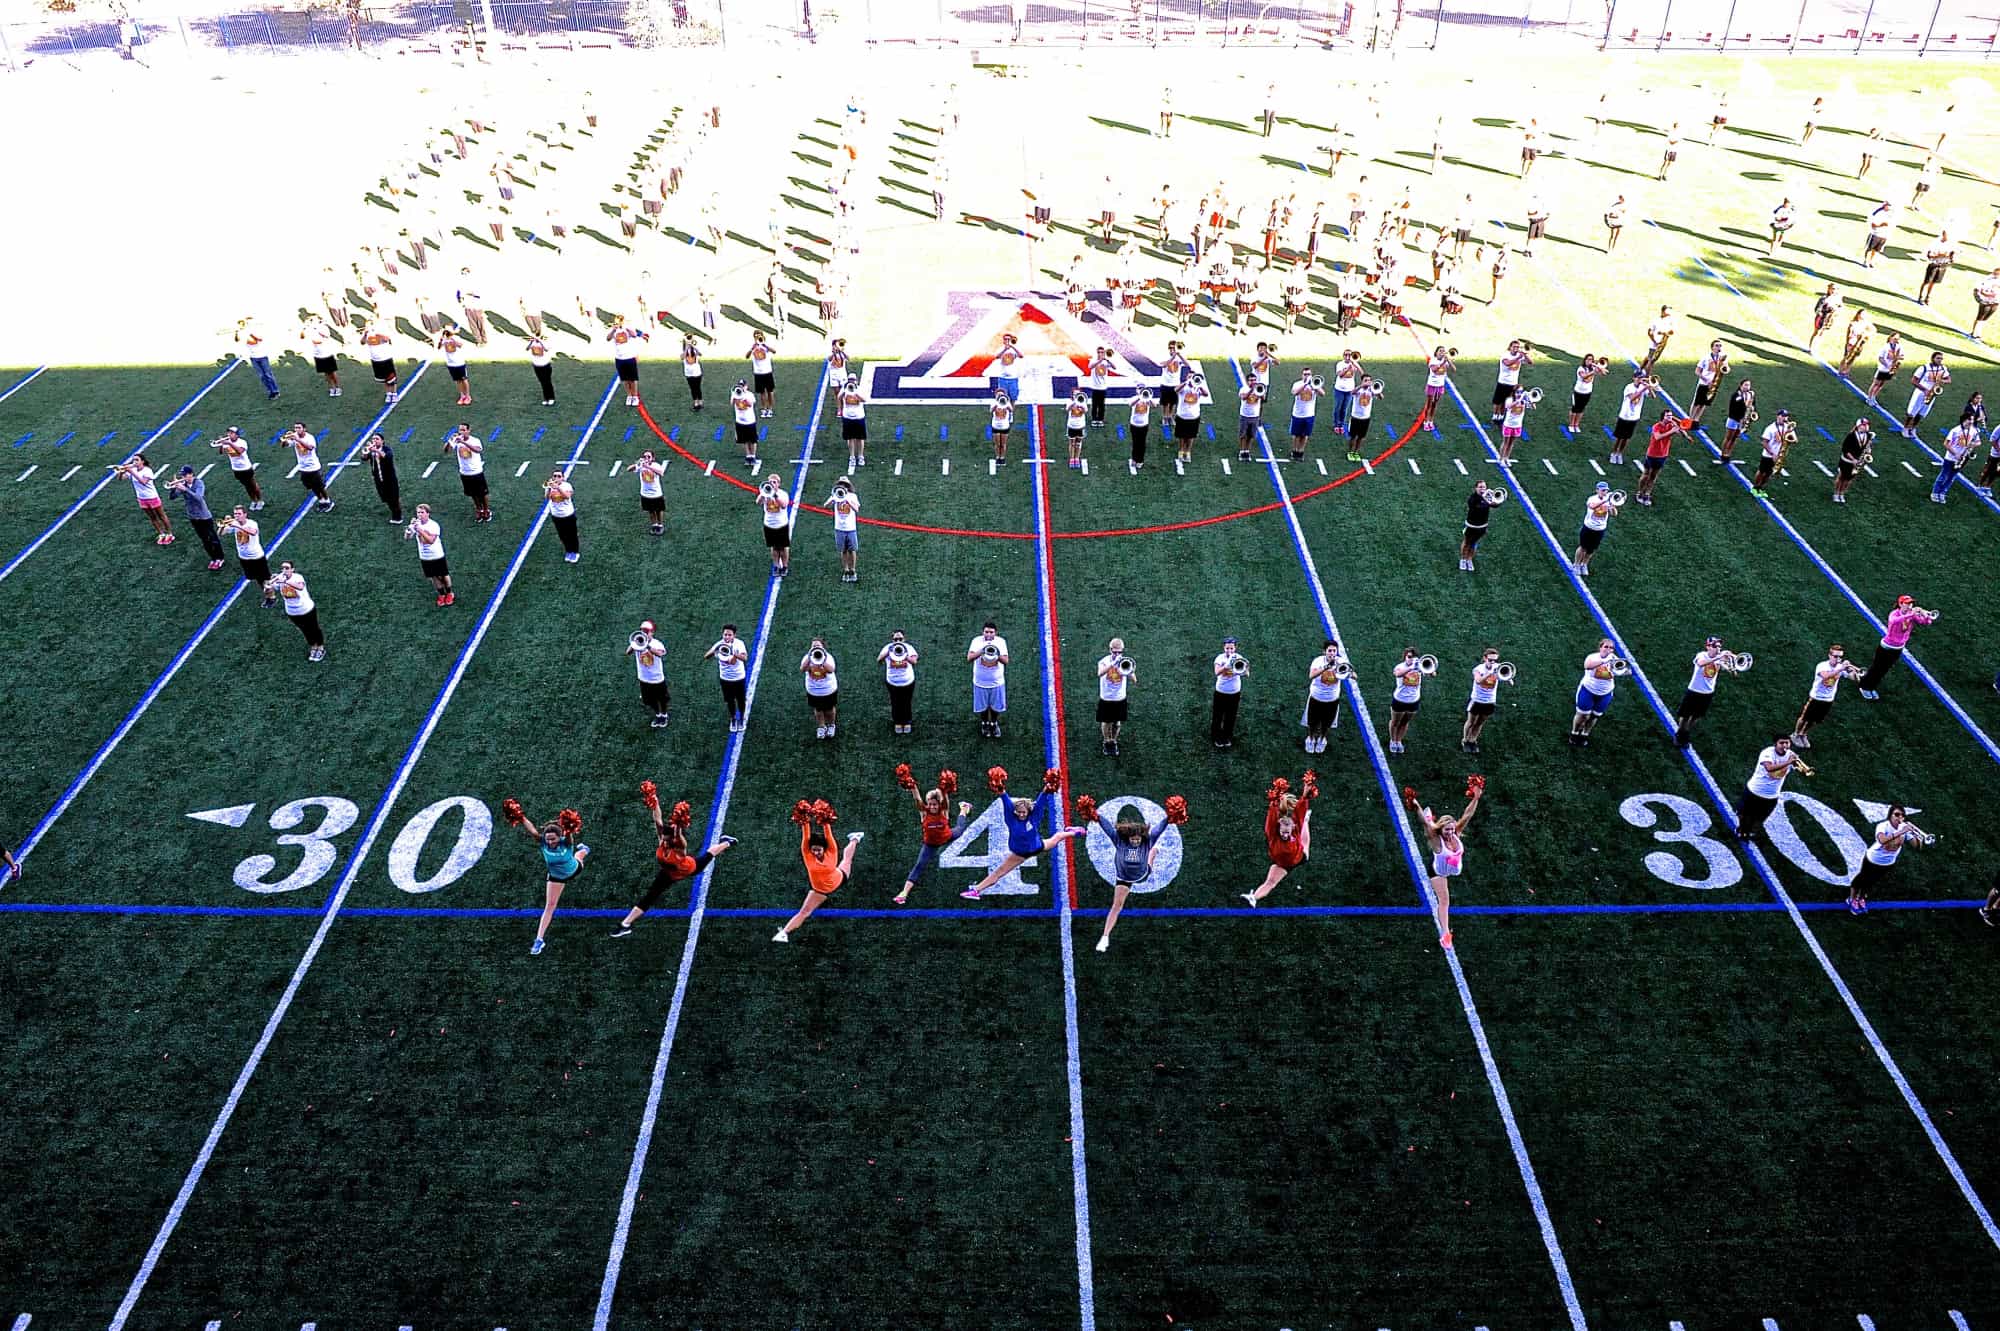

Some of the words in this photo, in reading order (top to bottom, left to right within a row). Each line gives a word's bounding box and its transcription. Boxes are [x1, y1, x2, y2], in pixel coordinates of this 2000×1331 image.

[233, 796, 493, 893] 30
[939, 796, 1183, 894] 40
[1619, 791, 1867, 889] 30
